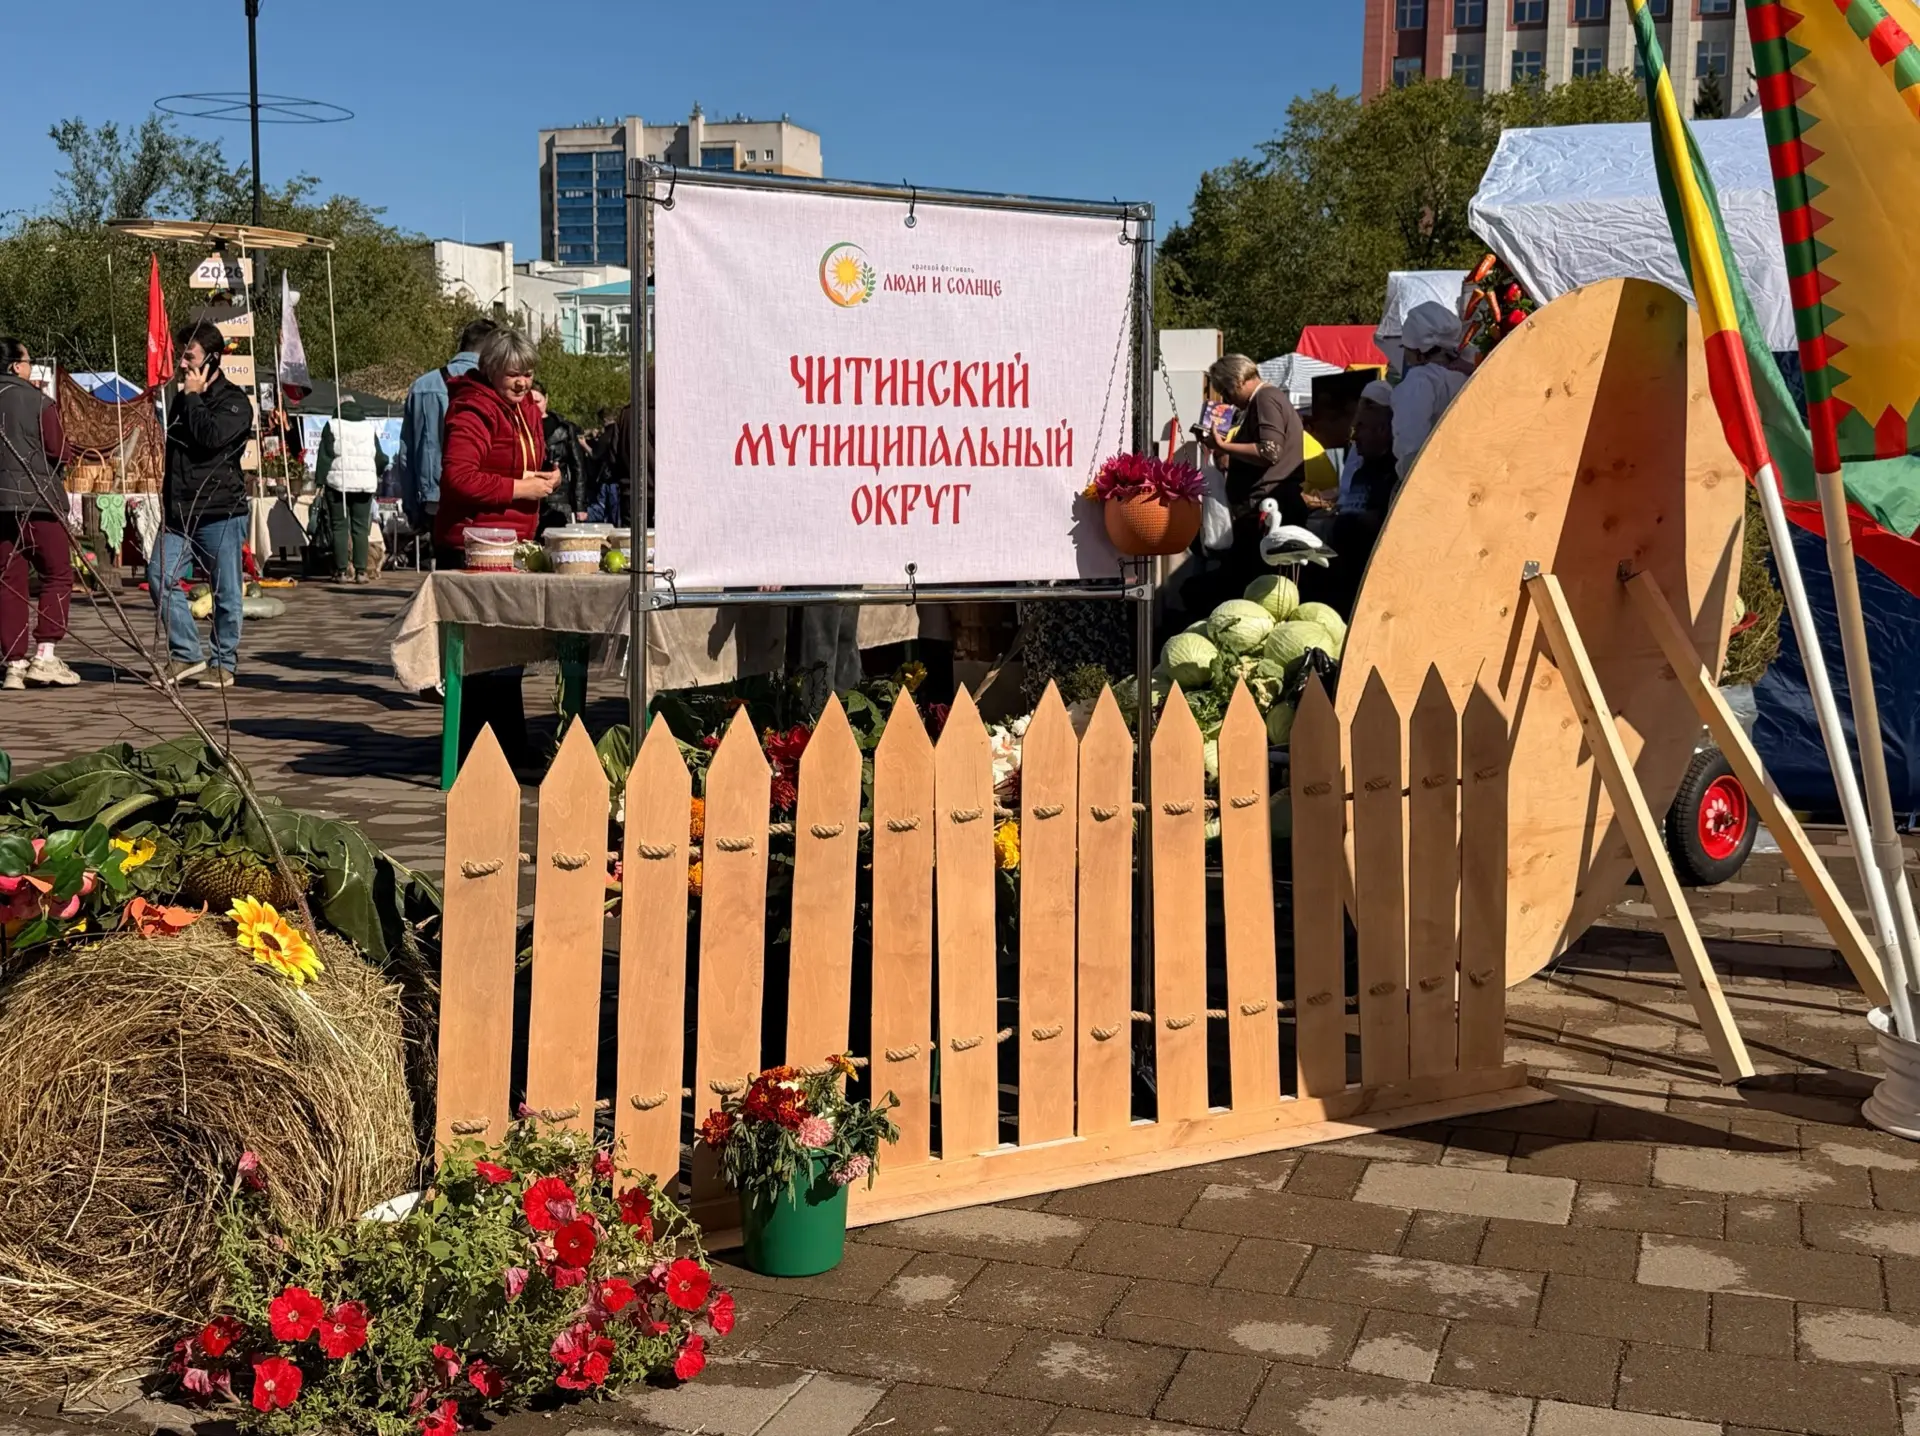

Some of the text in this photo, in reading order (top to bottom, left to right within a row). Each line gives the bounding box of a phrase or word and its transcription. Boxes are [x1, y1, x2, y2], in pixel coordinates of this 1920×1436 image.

[200, 266, 244, 279] 2026
[911, 264, 939, 272] краевой
[883, 273, 1002, 299] ЛЮДИ И СОЛНЦЕ
[790, 352, 1030, 408] ЧИТИНСКИЙ
[734, 418, 1073, 475] МУНИЦИПАЛЬНЫЙ
[851, 483, 972, 526] ОКРУГ
